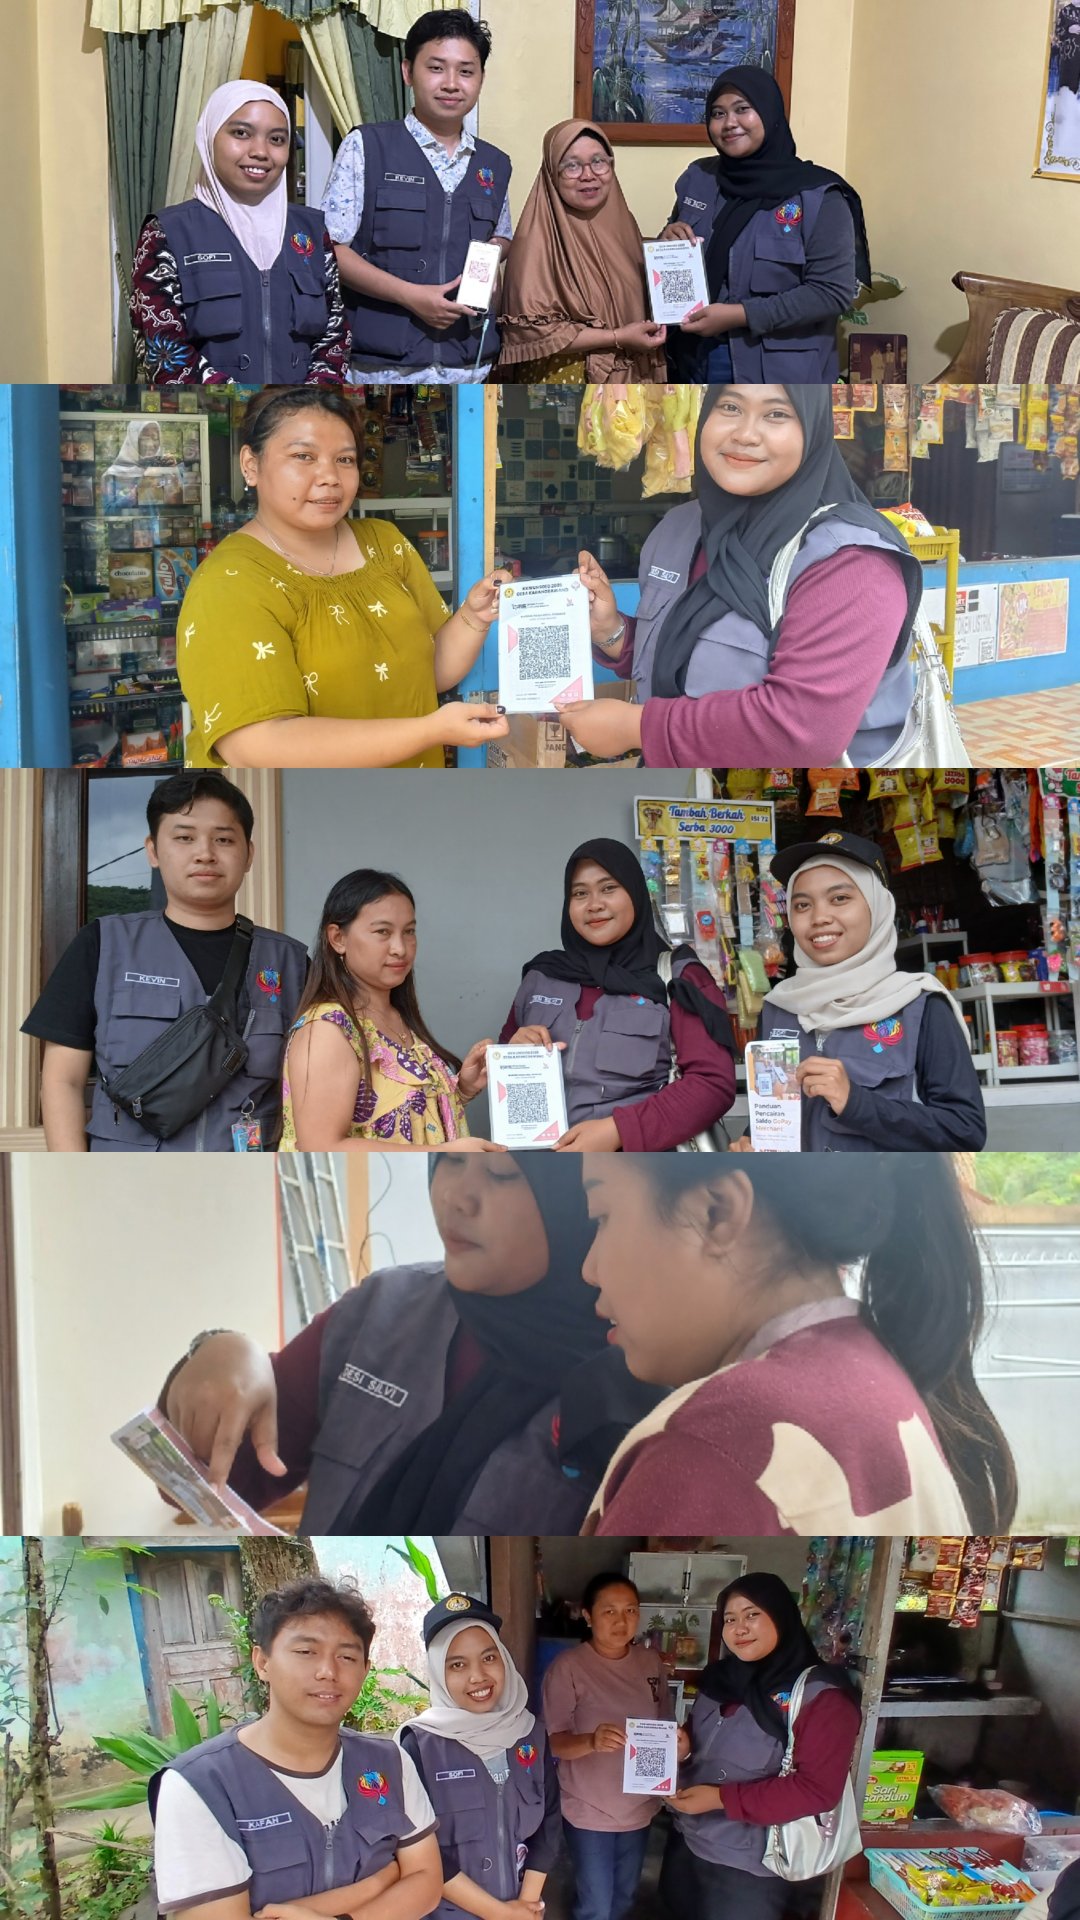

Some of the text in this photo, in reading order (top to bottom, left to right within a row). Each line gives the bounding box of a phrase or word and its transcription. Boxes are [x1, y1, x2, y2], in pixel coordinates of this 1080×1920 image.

[669, 805, 707, 819] Tambah
[709, 807, 744, 820] Berkah
[678, 822, 734, 834] Serba 3000
[139, 975, 166, 984] KEVIN
[367, 1380, 397, 1399] SILVI
[873, 1785, 899, 1794] Sari
[248, 1816, 279, 1829] KAFAH
